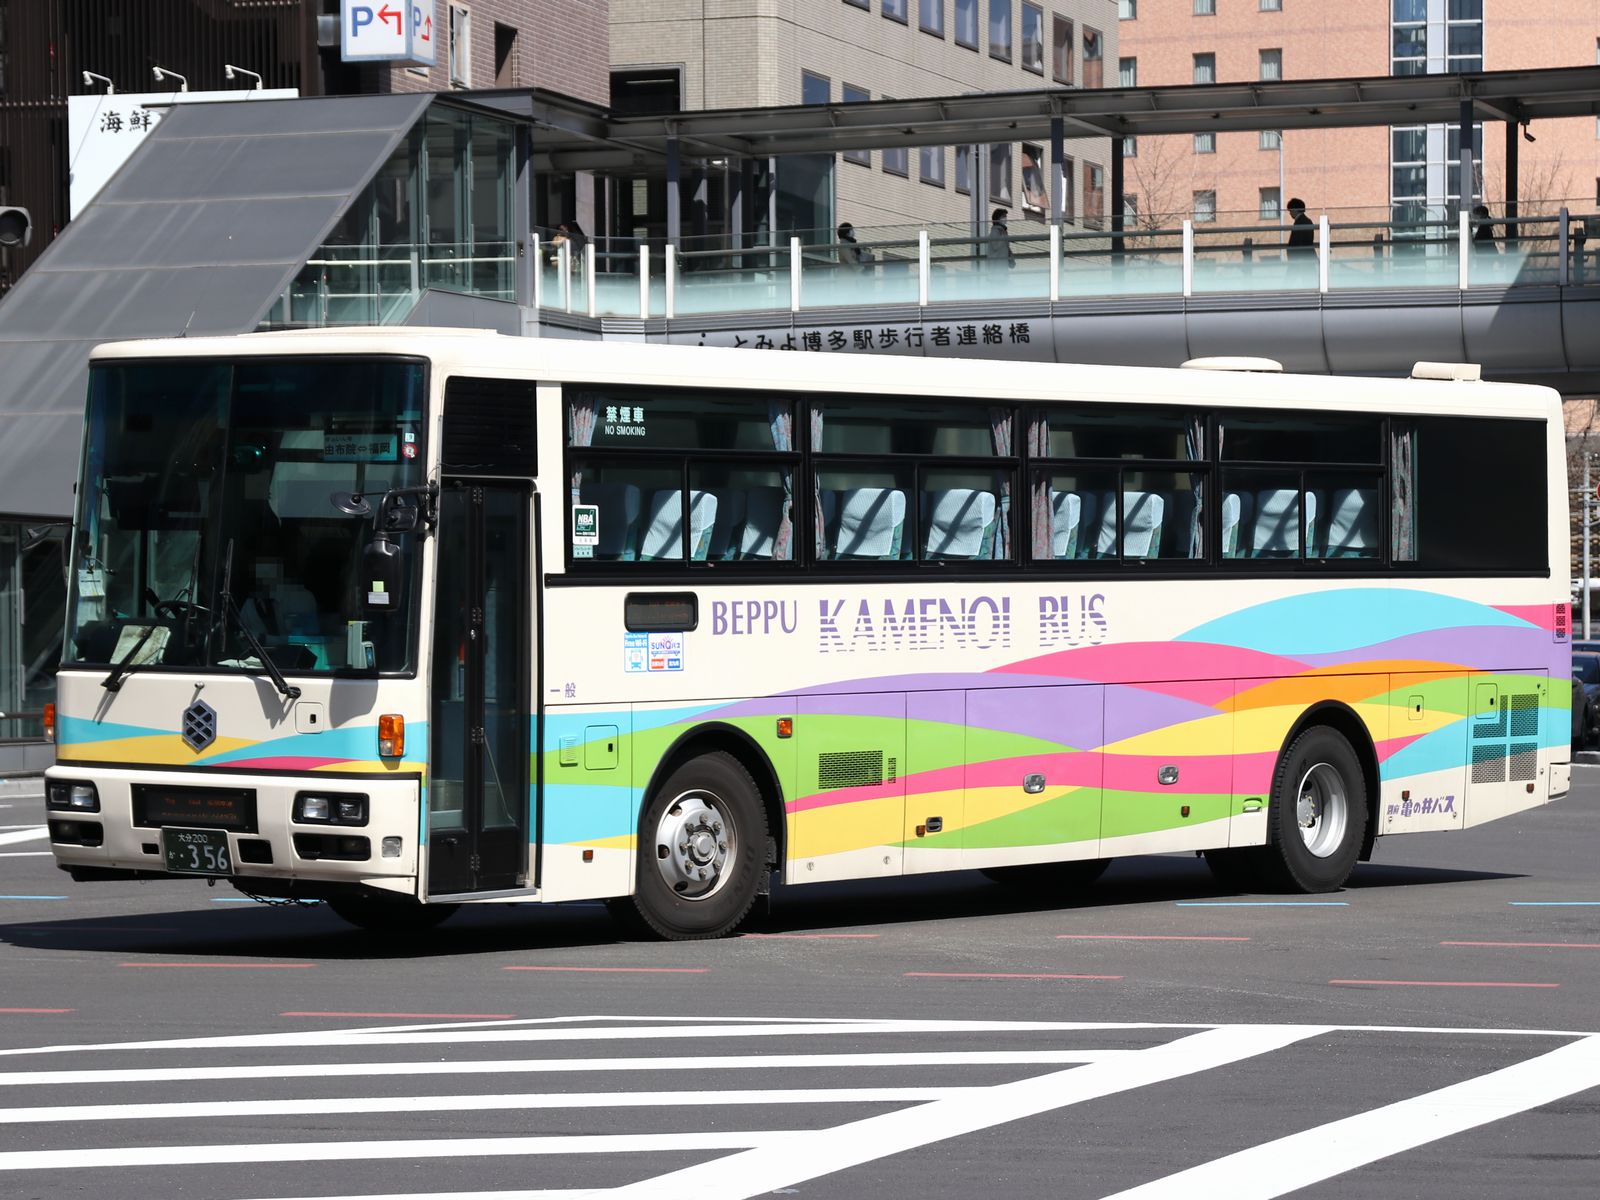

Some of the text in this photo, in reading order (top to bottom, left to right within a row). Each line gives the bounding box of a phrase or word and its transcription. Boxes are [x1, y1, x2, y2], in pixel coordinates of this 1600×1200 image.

[352, 6, 374, 37] P
[413, 6, 422, 37] P
[100, 110, 152, 133] 海鮮
[699, 322, 1030, 351] とみよ博多駅歩行者連絡橋
[606, 406, 644, 423] 禁煙車
[605, 425, 646, 436] NO SMOKING
[325, 442, 391, 455] 由布院 福岡
[577, 514, 594, 525] NBA
[712, 593, 1107, 653] BEPPU KAMENOI BUS
[550, 682, 576, 698] 一般
[1401, 795, 1455, 817] 亀の井バス
[187, 844, 228, 870] 356
